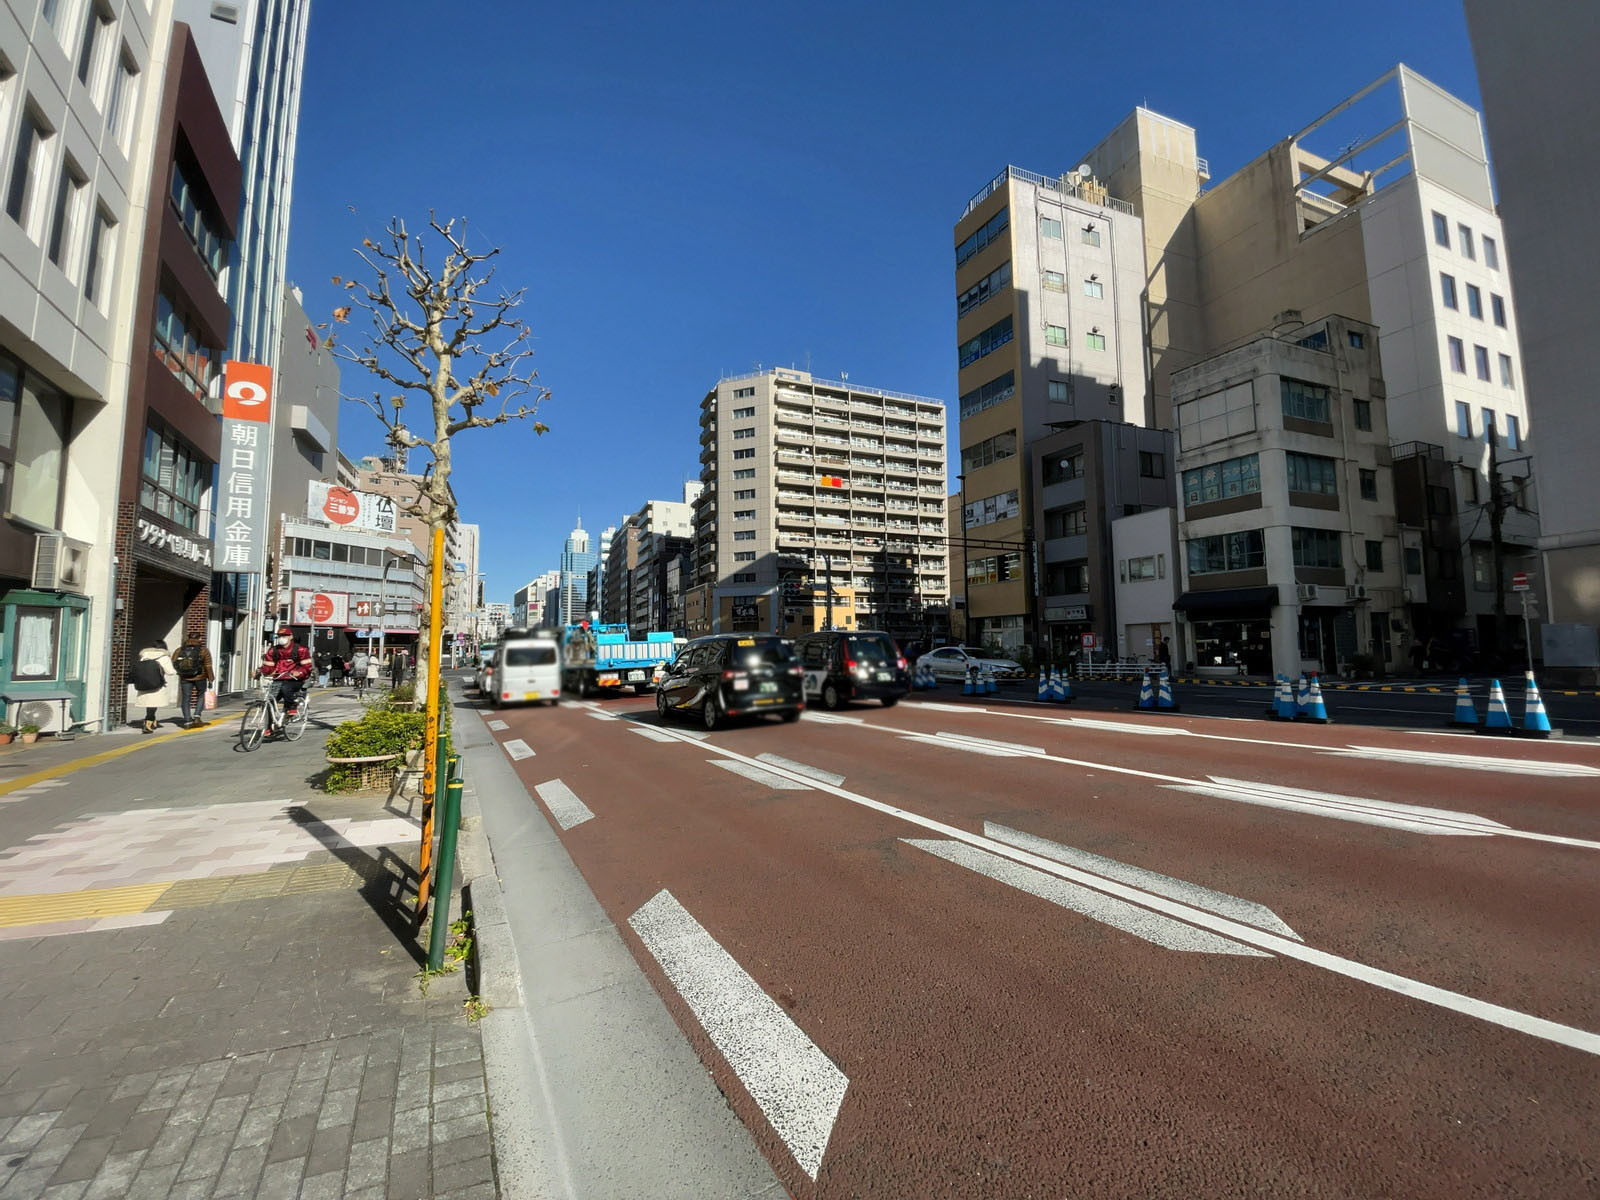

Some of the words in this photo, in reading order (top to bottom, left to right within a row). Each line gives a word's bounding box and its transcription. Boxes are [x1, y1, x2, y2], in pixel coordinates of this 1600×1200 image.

[222, 423, 258, 566] 朝日信用金庫
[376, 498, 394, 530] 仏壇
